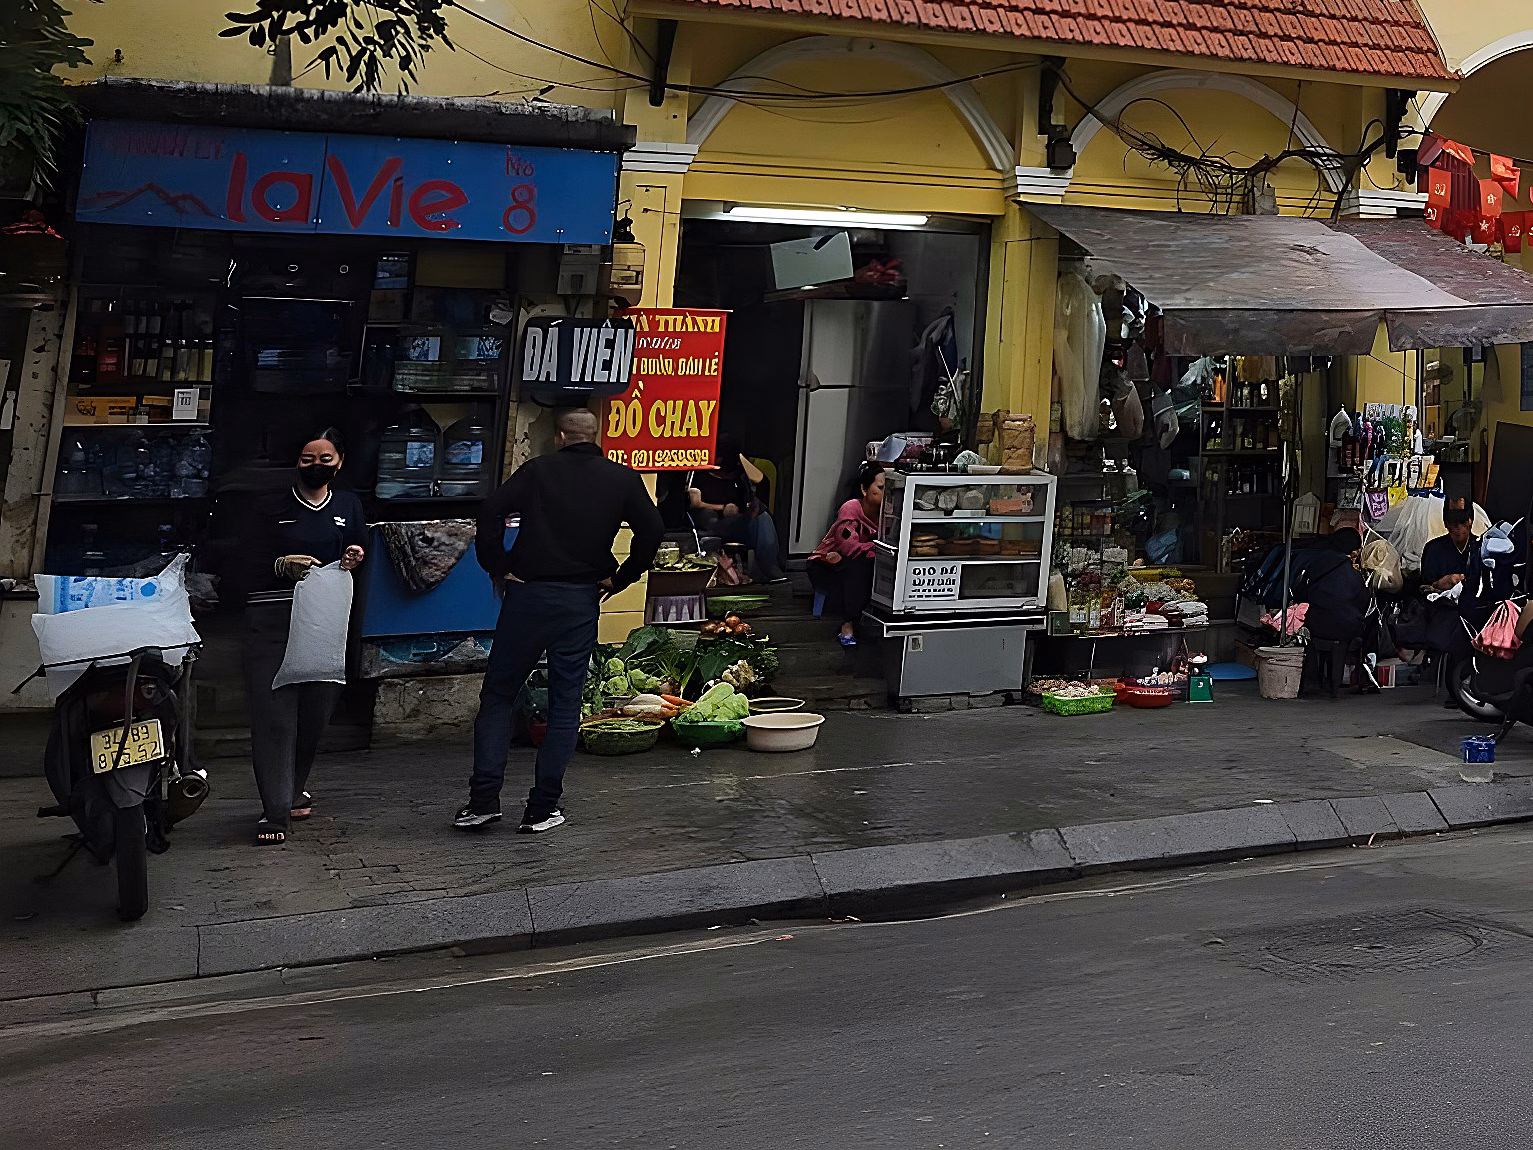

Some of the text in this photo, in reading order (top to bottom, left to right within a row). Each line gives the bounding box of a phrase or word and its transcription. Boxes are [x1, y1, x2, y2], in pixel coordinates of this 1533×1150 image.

[502, 182, 537, 235] 8
[522, 318, 635, 382] ĐÁ VIÊN
[607, 381, 717, 438] ĐỒ CHAY
